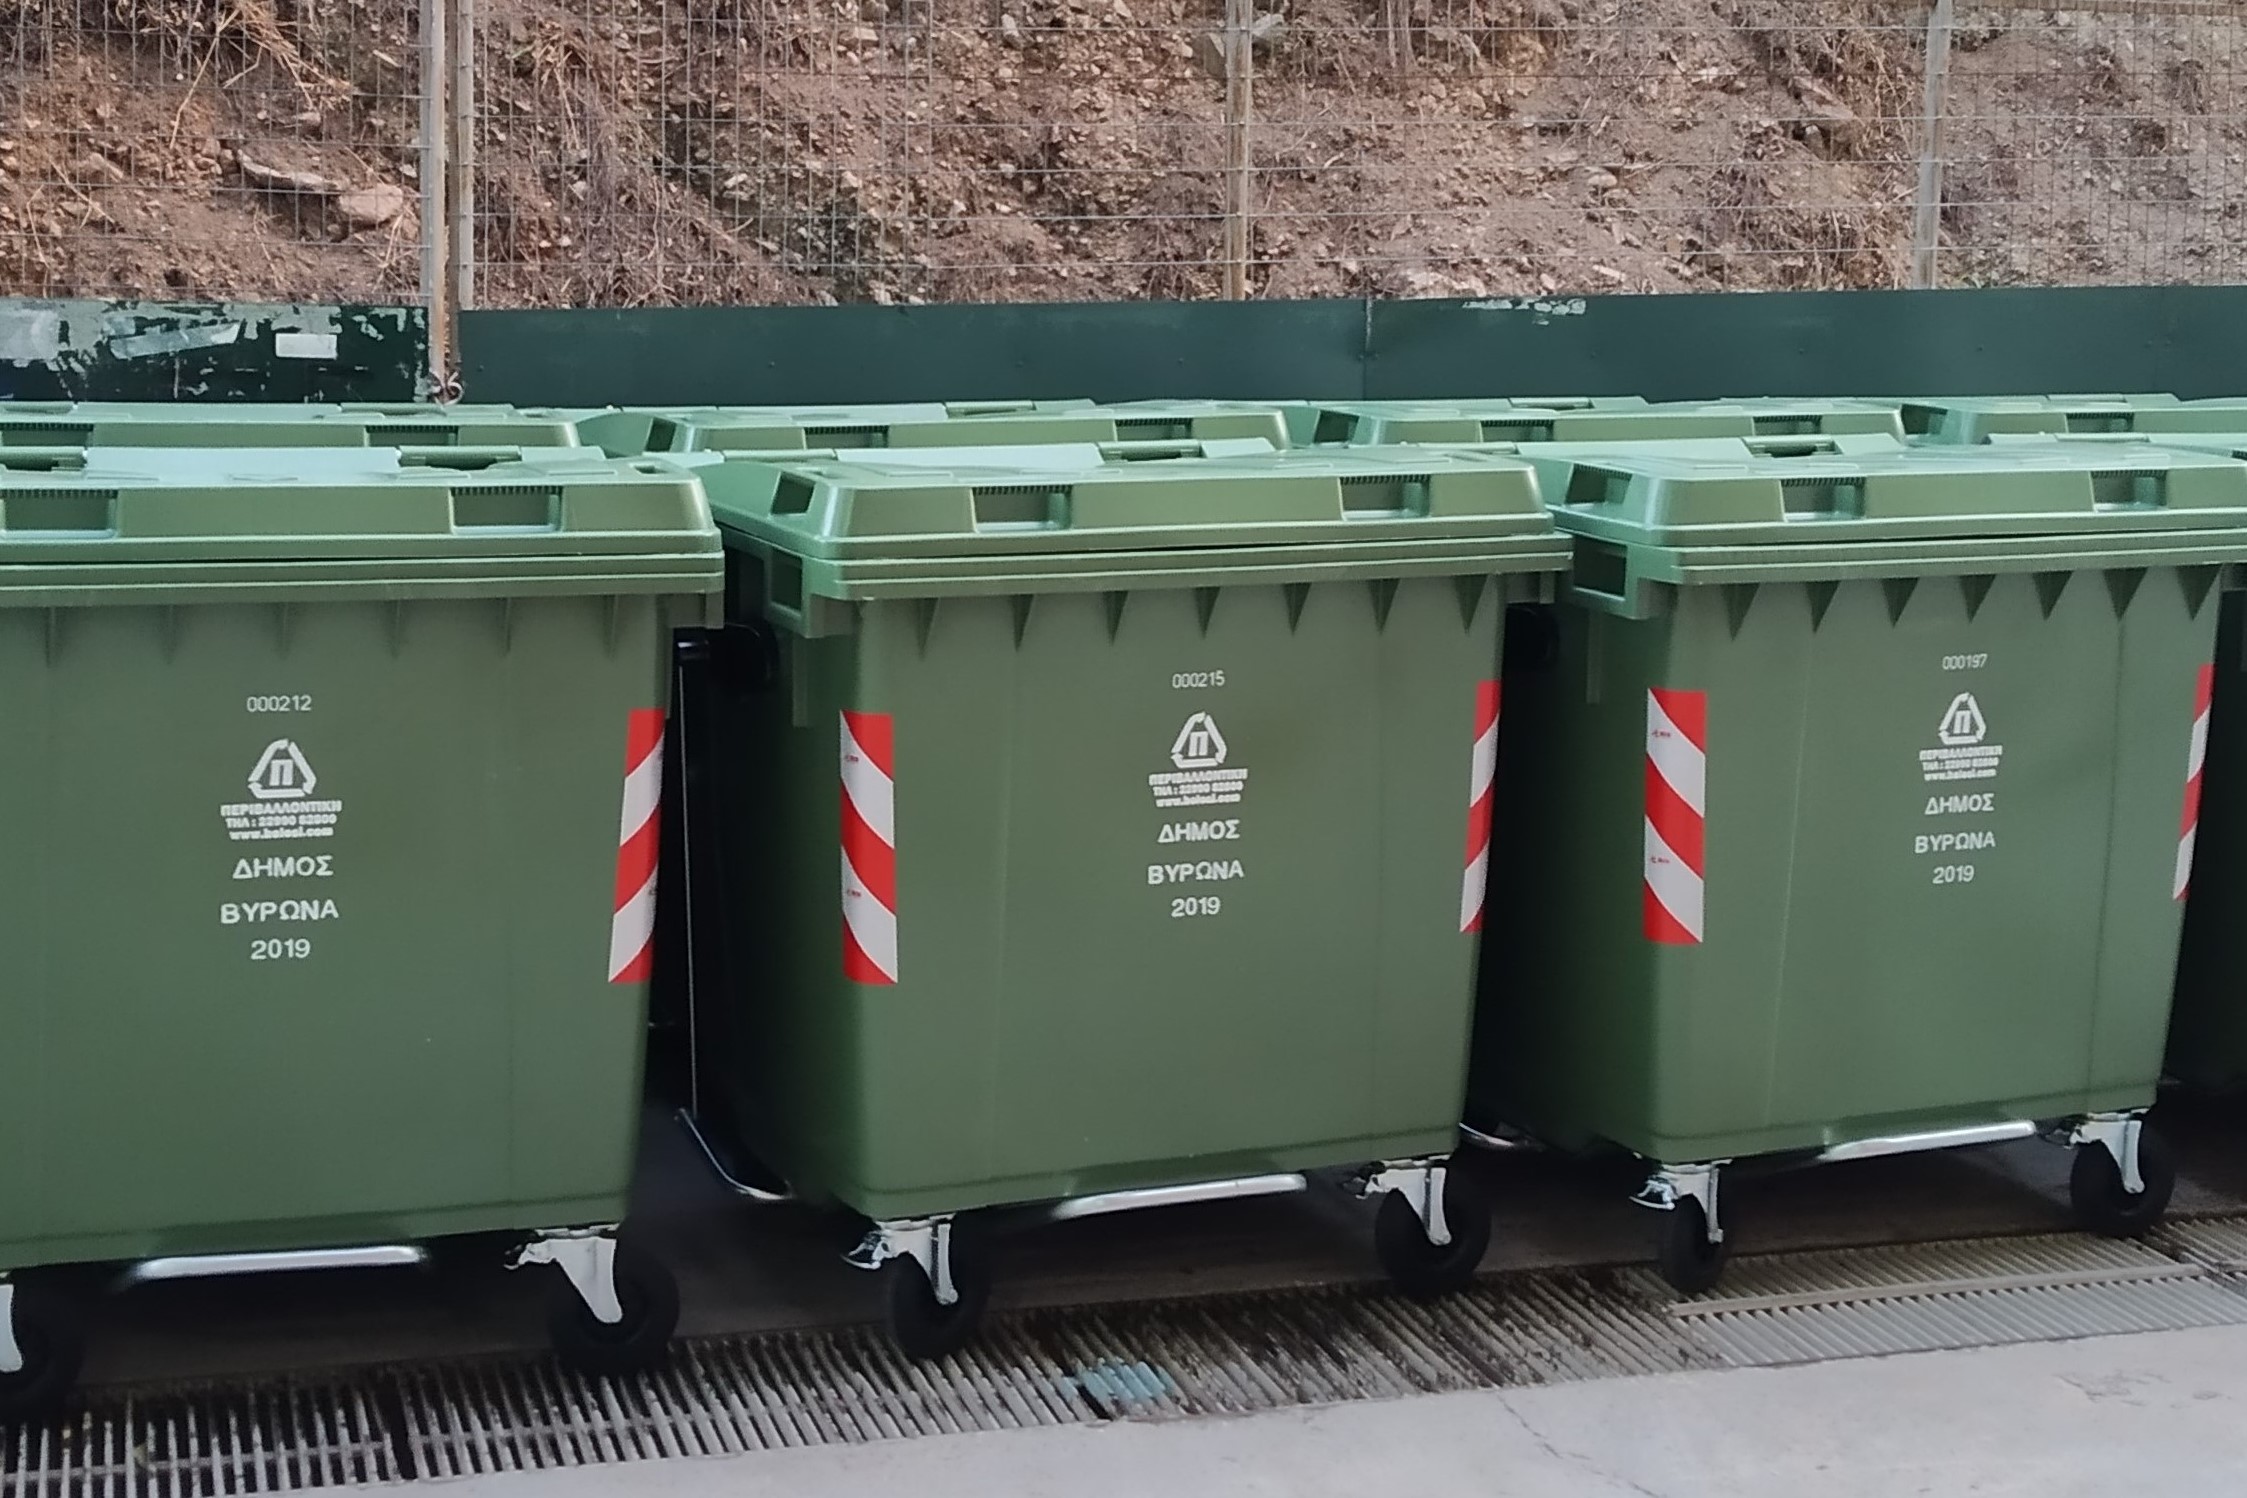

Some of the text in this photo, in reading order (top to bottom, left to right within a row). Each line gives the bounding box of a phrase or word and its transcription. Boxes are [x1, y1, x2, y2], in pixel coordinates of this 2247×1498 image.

[1942, 653, 1988, 670] 000197
[1171, 670, 1225, 688] 000215
[246, 695, 312, 712] 000212
[1924, 793, 1995, 815] ΔΗΜΟΣ
[1157, 819, 1241, 843] ΔΗΜΟΣ
[1914, 831, 1997, 854] ΒΥΡΩΝΑ
[232, 855, 334, 879] ΔΗΜΟΣ
[1147, 860, 1245, 885] ΒΥΡΩΝΑ
[1932, 864, 1975, 884] 2019
[220, 899, 339, 924] ΒΥΡΩΝΑ
[1171, 896, 1221, 918] 2019
[250, 938, 311, 960] 2019
